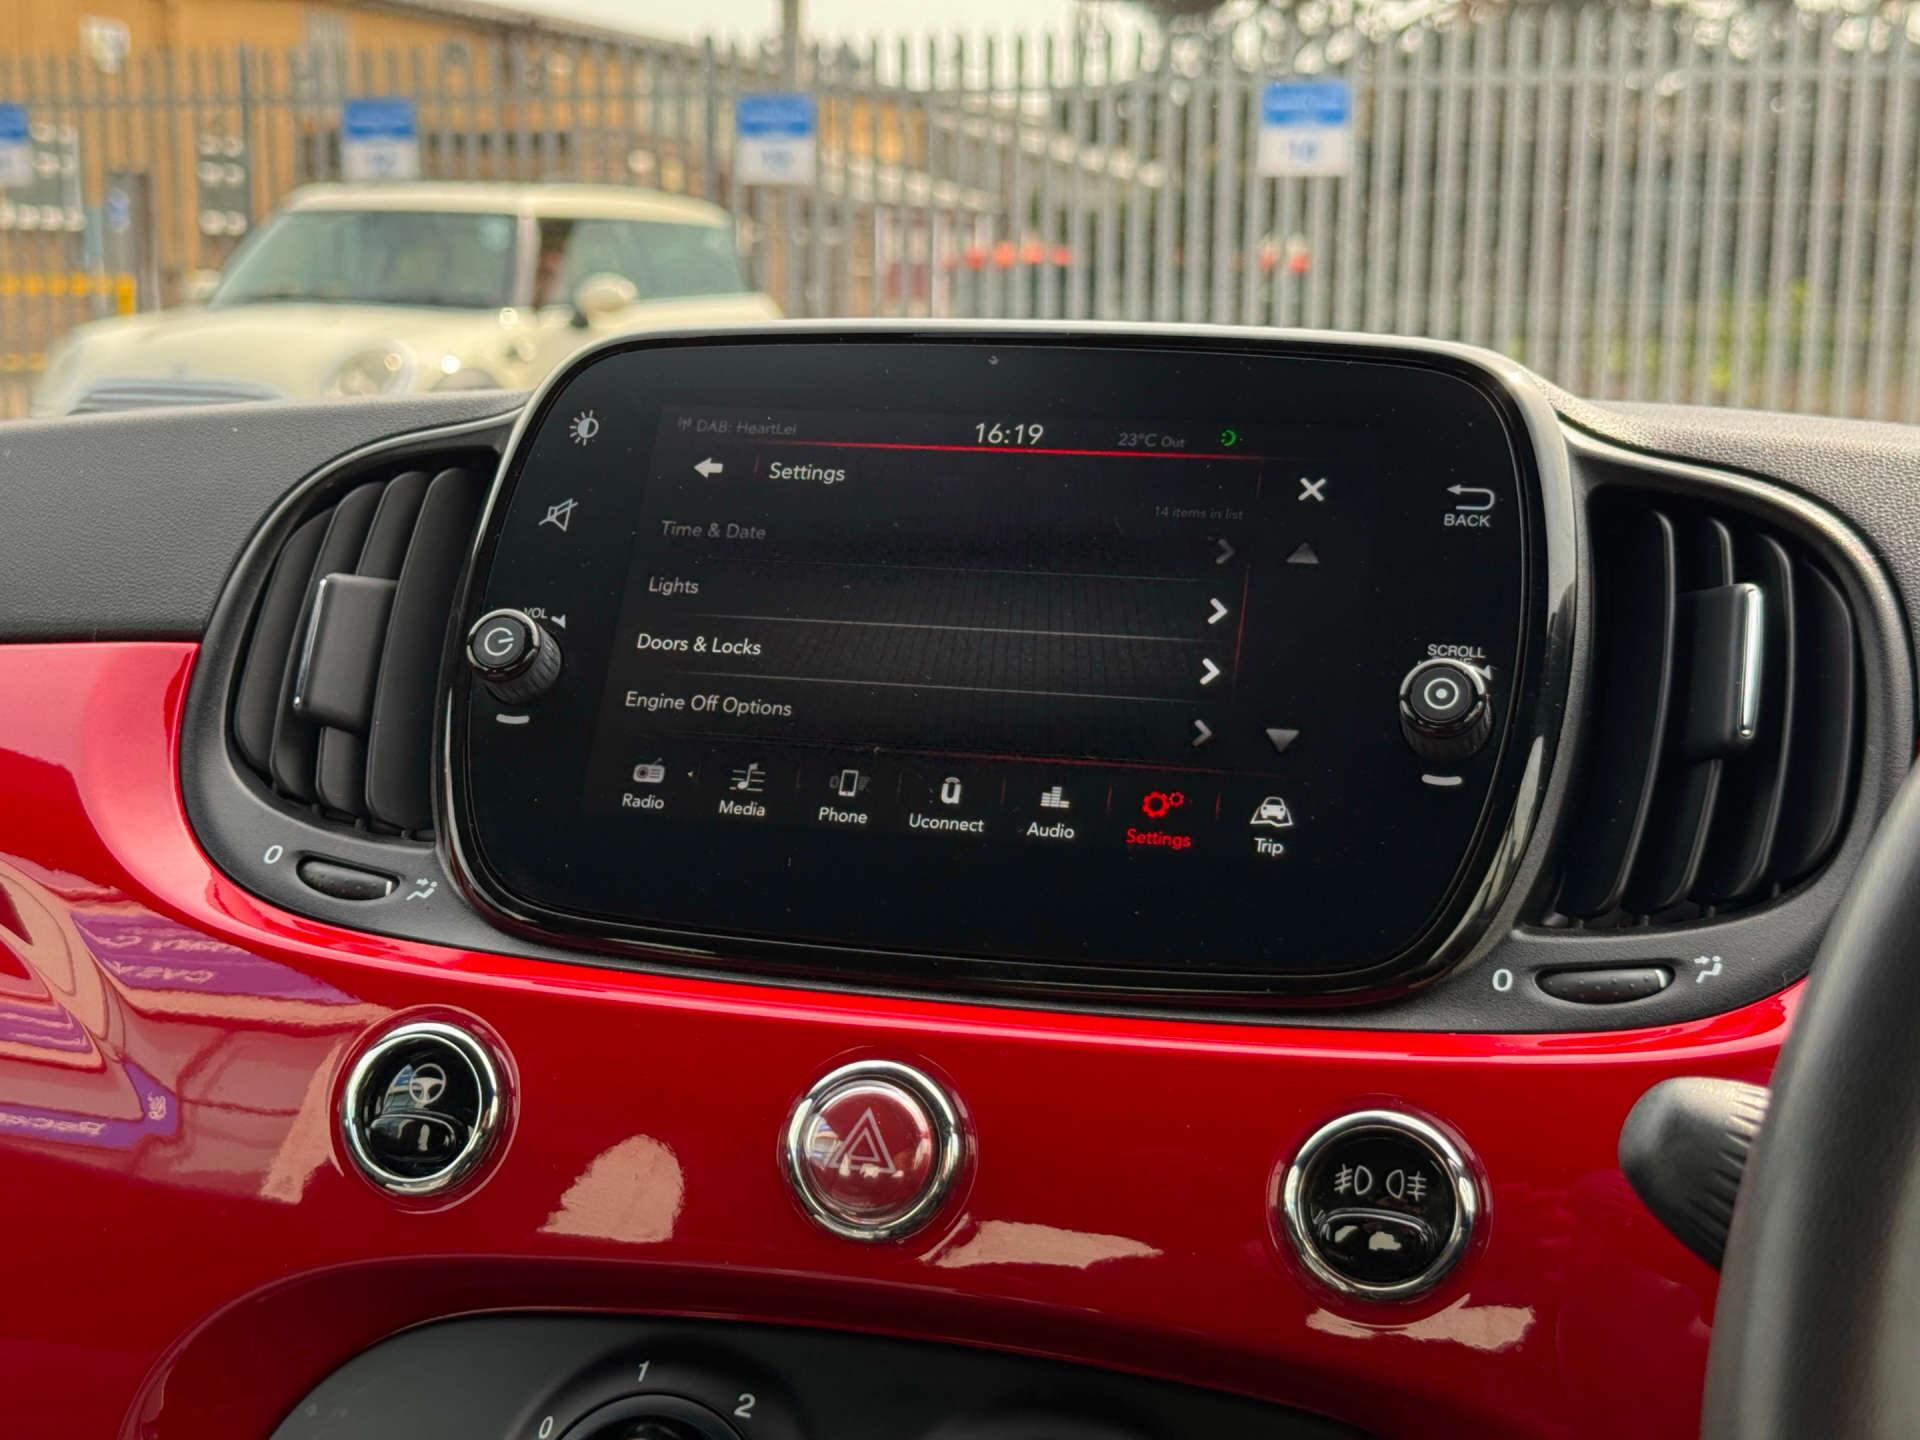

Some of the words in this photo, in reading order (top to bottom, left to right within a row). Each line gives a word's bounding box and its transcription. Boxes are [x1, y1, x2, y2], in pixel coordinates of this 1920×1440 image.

[975, 422, 1044, 446] 16:19
[1161, 435, 1185, 448] Out
[768, 461, 846, 485] Settings
[1154, 505, 1169, 518] 14
[1172, 506, 1207, 519] items
[1210, 507, 1222, 520] in
[1225, 508, 1243, 520] list
[1443, 513, 1491, 527] BACK
[661, 520, 702, 538] Time
[707, 522, 720, 539] &
[726, 523, 767, 540] Date
[648, 576, 699, 595] Lights
[524, 607, 548, 619] VOL
[637, 633, 689, 651] Doors
[693, 636, 706, 653] &
[711, 637, 762, 656] Locks
[1427, 643, 1487, 659] SCROLL
[625, 691, 685, 712] Engine
[690, 695, 720, 712] Off
[722, 696, 792, 718] Options
[622, 793, 665, 811] Radio
[718, 800, 766, 817] Media
[818, 807, 869, 825] Phone
[908, 813, 985, 833] Uconnect
[1026, 822, 1075, 839] Audio
[1126, 829, 1191, 850] Settings
[1254, 838, 1284, 857] Trip
[636, 1360, 650, 1383] 1
[734, 1393, 756, 1419] 2
[538, 1415, 554, 1440] 0
